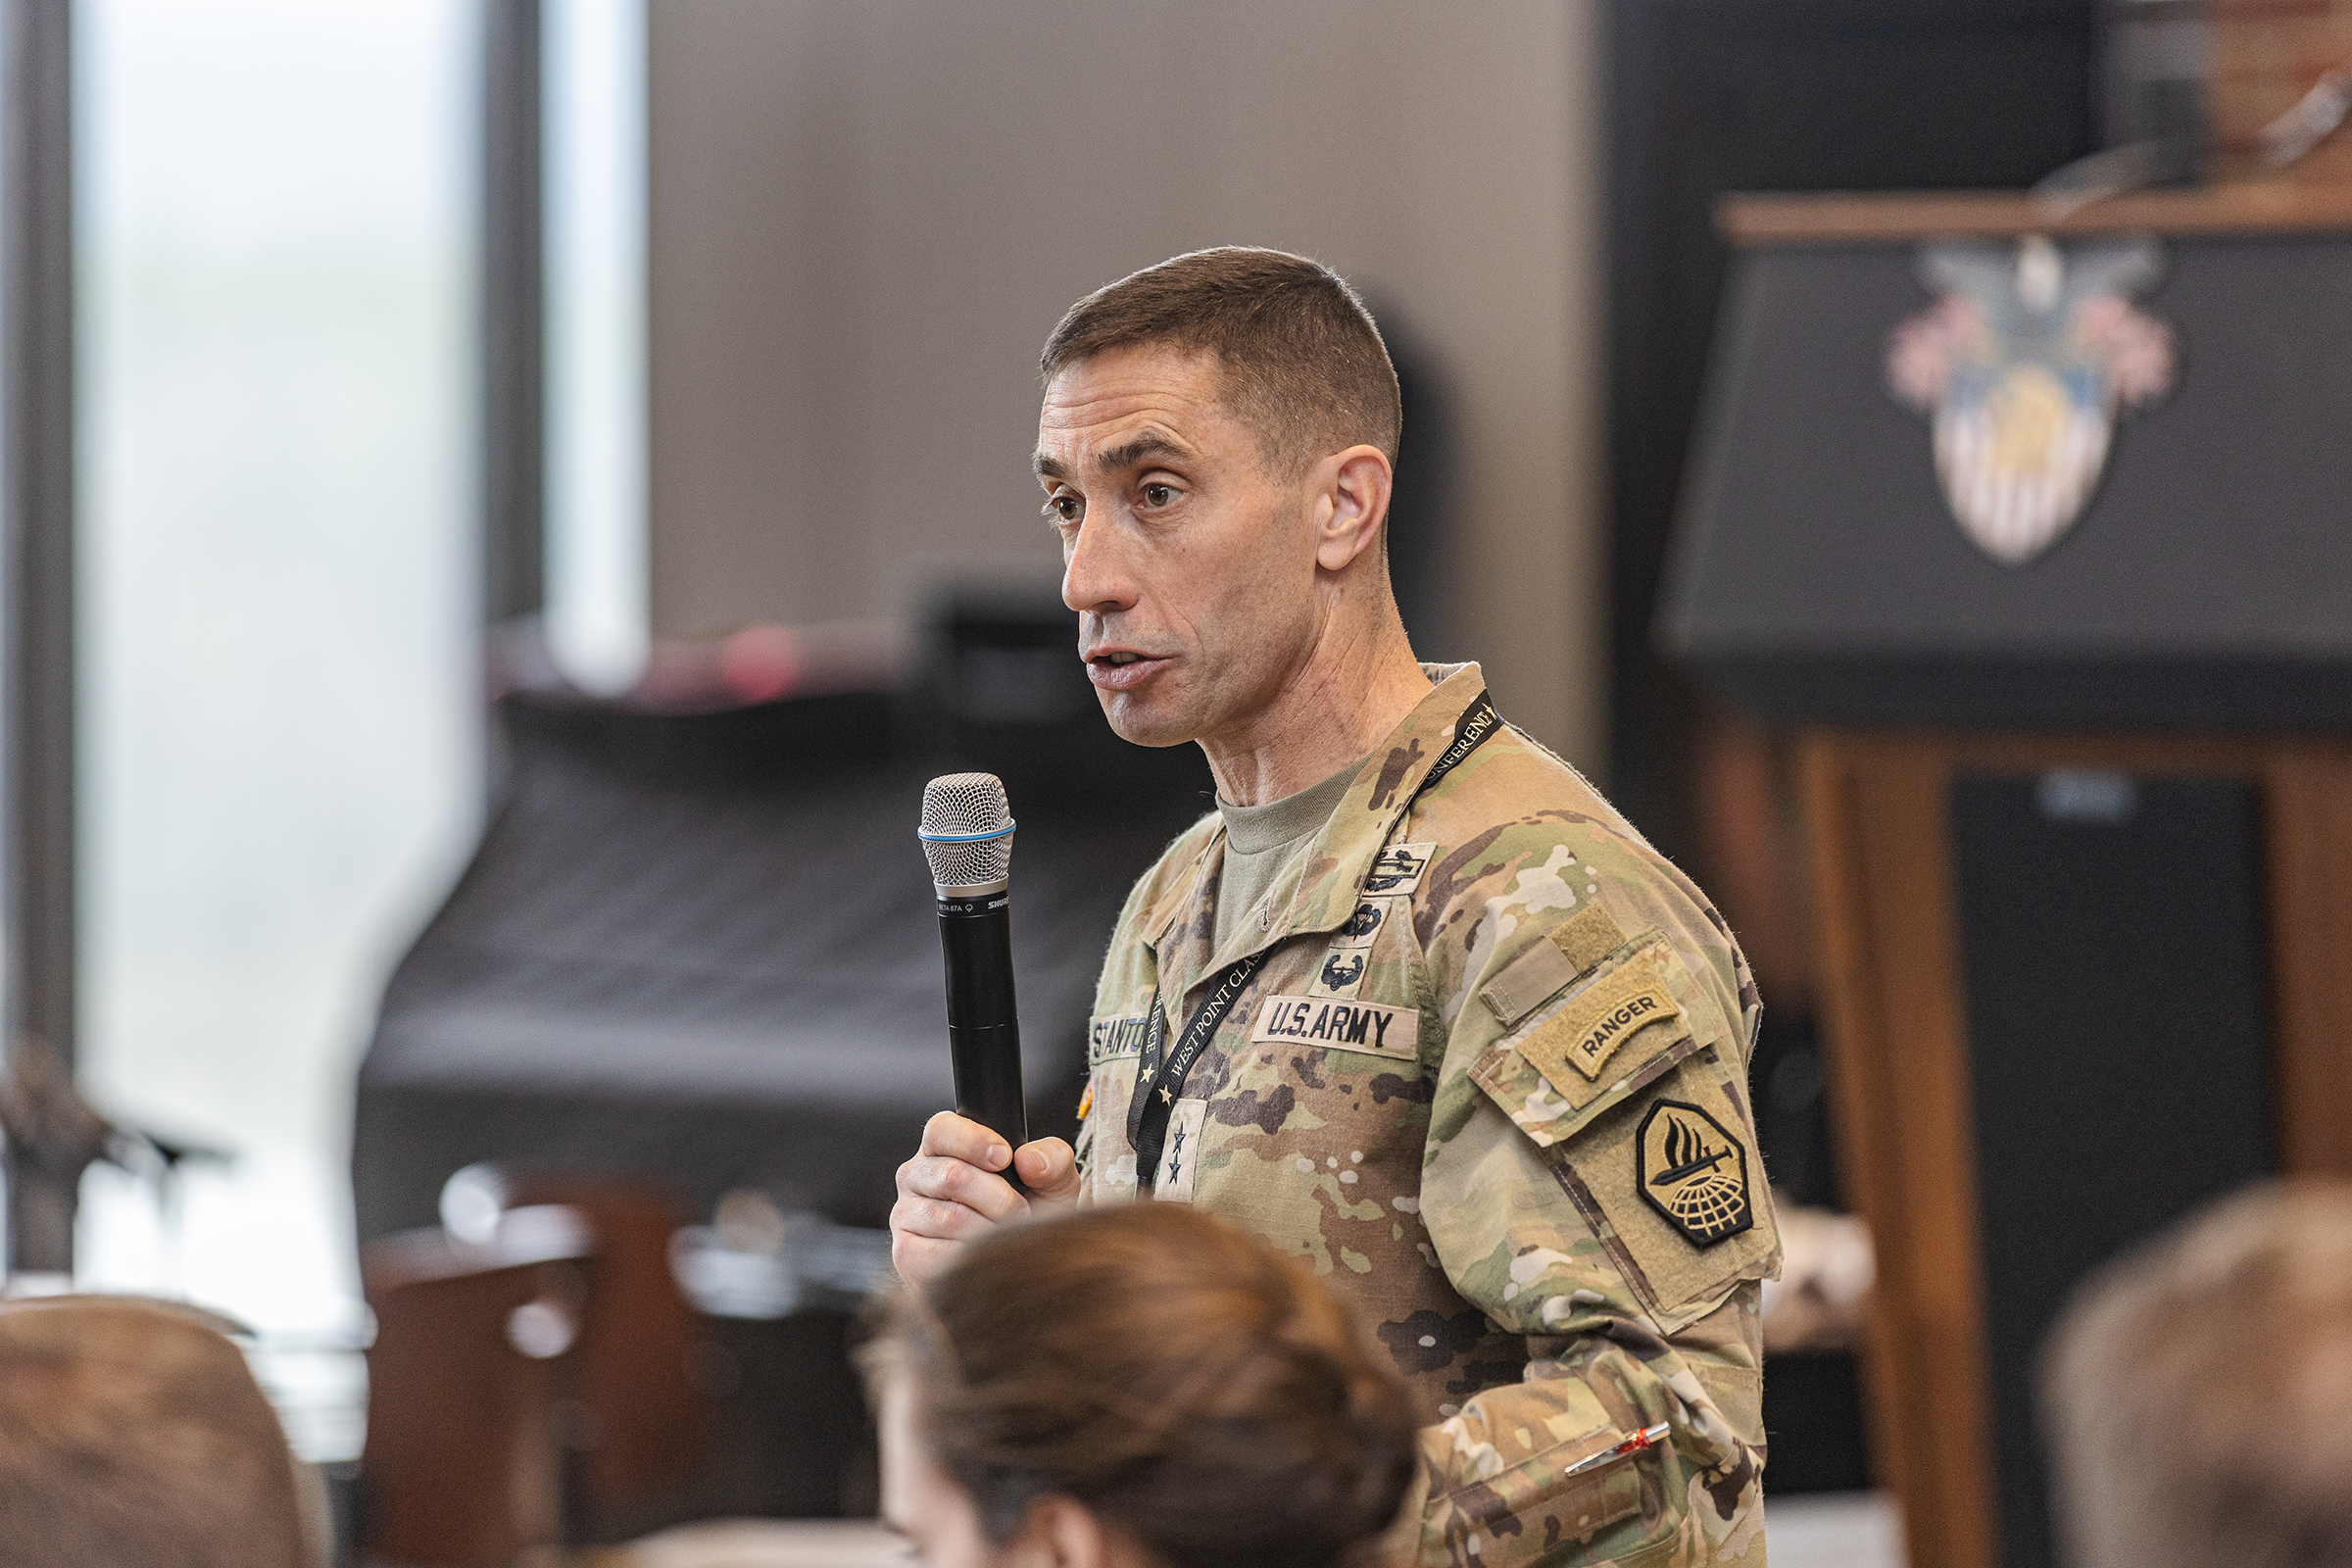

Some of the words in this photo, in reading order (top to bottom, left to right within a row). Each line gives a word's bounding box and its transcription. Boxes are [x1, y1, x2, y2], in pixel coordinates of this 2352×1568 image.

[1093, 1017, 1147, 1058] STANTO
[1171, 1031, 1200, 1077] WEST
[1196, 984, 1231, 1037] POINT
[1582, 996, 1658, 1057] RANGER
